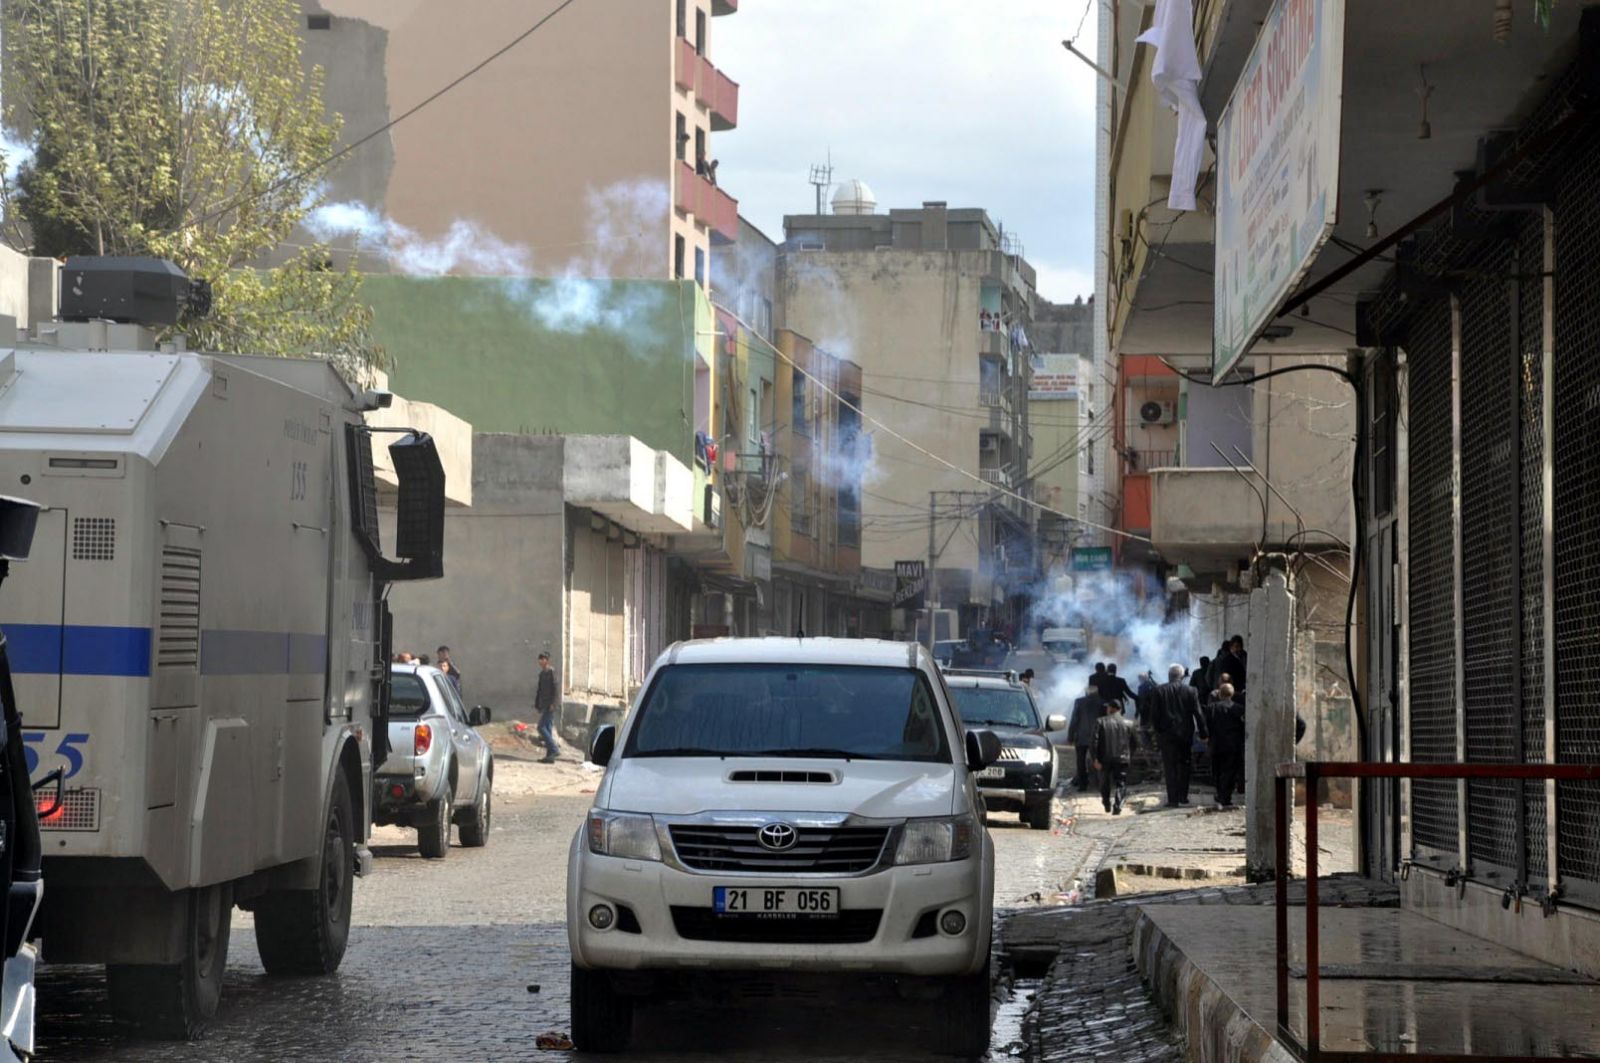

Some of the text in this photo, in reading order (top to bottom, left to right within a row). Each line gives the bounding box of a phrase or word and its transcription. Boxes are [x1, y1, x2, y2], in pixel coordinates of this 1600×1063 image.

[728, 890, 748, 910] 21
[764, 890, 785, 911] BF
[797, 891, 831, 911] 056
